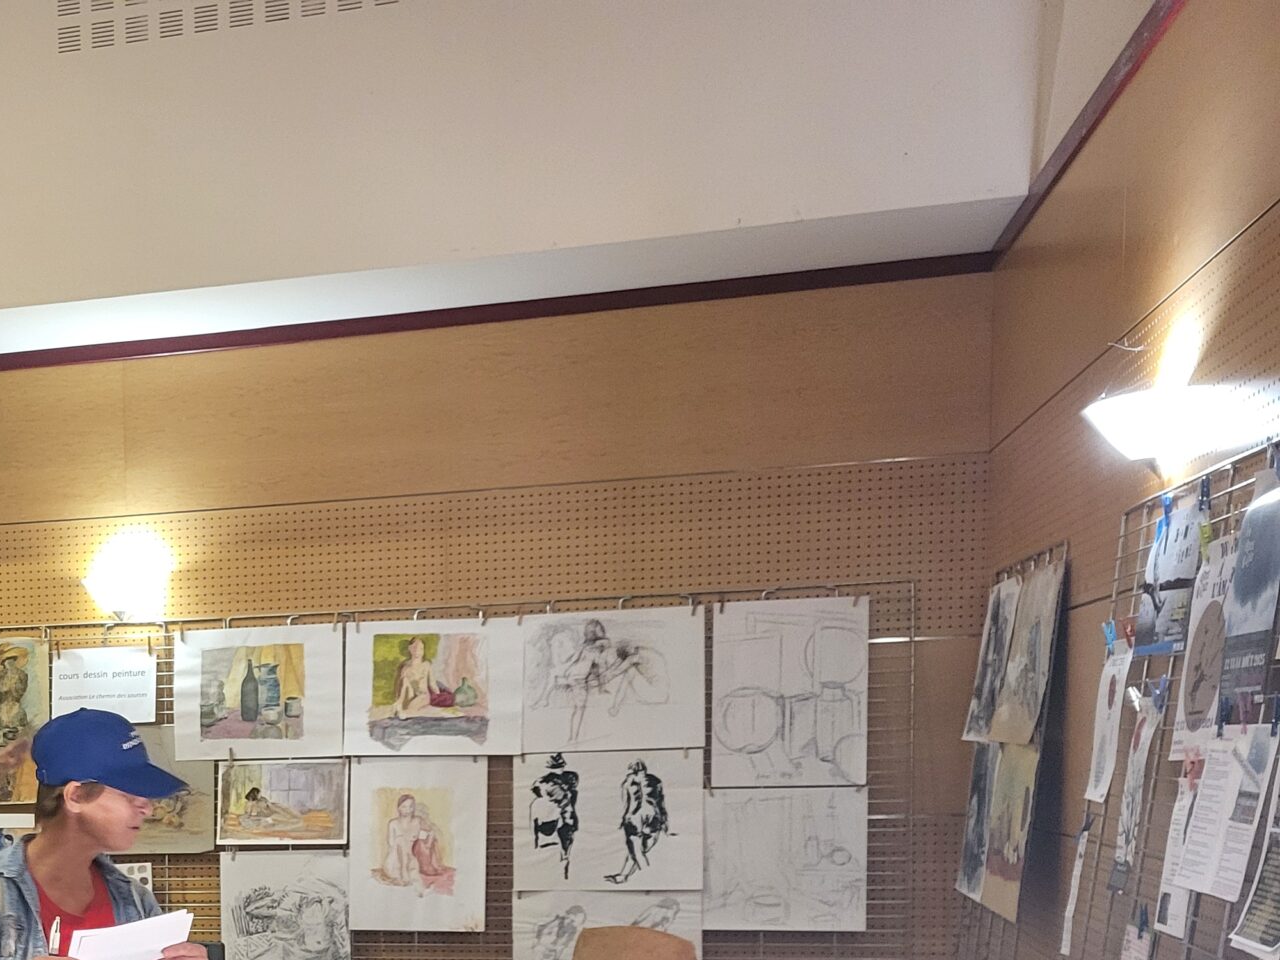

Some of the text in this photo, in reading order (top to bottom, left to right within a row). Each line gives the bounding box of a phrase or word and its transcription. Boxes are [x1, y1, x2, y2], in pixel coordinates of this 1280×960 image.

[59, 669, 146, 680] cours dessin peinture
